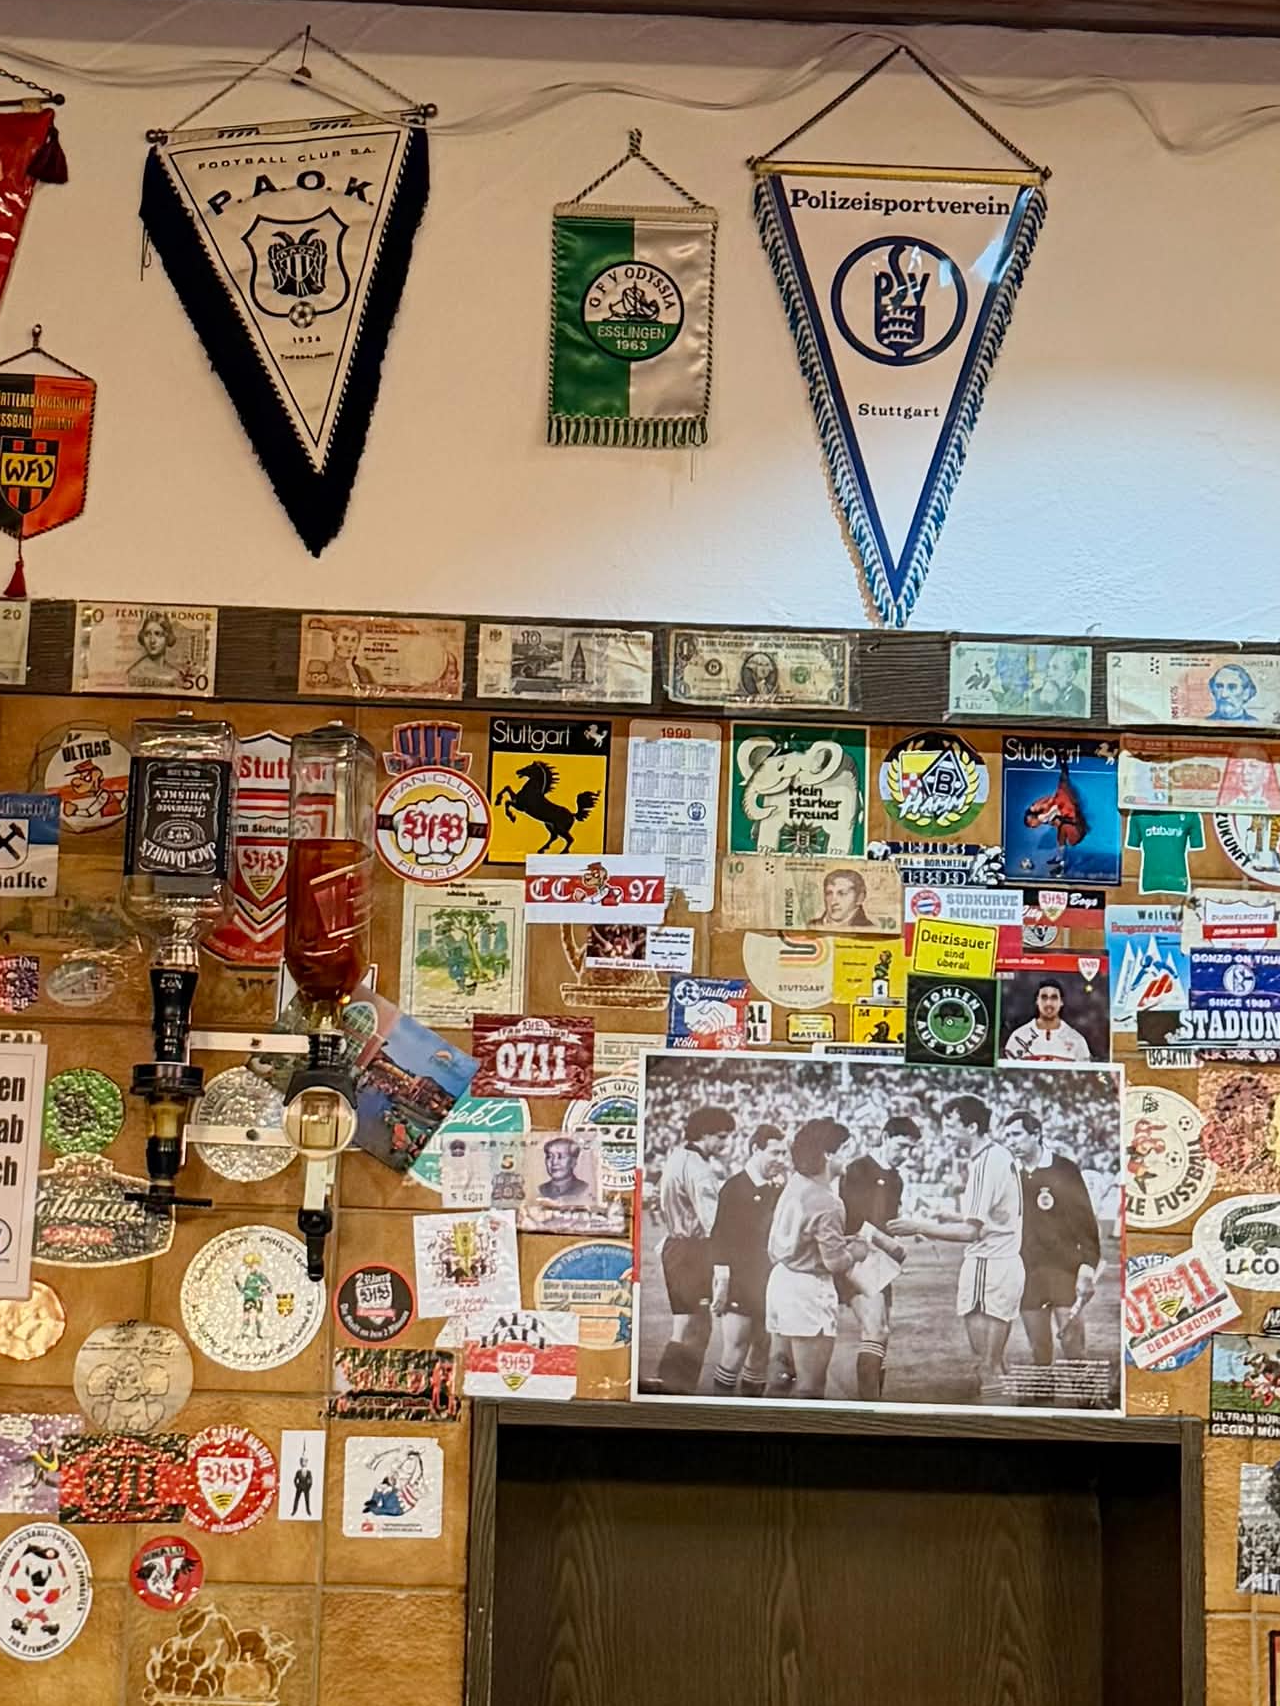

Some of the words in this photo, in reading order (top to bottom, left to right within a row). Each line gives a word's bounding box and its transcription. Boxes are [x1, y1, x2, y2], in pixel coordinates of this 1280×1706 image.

[197, 156, 288, 171] FOOTBALL
[297, 150, 342, 164] CLUB
[789, 188, 1010, 217] Polizeisportverein
[624, 266, 677, 311] ODYSSIA
[596, 324, 667, 342] ESSLINGEN
[614, 340, 649, 353] 1963
[857, 402, 941, 420] Stuttgart
[3, 458, 58, 485] WFV
[1, 608, 23, 622] 20
[520, 629, 542, 646] 10
[181, 673, 210, 691] 50
[491, 718, 572, 751] Stuttgart
[62, 739, 113, 762] ULTRAS
[1004, 739, 1081, 769] Stuttgrt
[386, 769, 483, 811] FAN-CLUB
[788, 783, 823, 798] Mein
[788, 797, 842, 811] starker
[899, 794, 967, 819] HAMM
[788, 808, 840, 822] Freund
[396, 859, 460, 879] FILDER
[628, 877, 660, 903] 97
[946, 892, 1021, 908] SÜDKURVE
[949, 906, 1017, 921] MÜNCHEN
[1210, 913, 1270, 923] DUNKELROTER
[920, 928, 993, 951] Deizisauer
[936, 957, 971, 971] überall
[943, 950, 966, 961] sind
[1191, 952, 1229, 965] GONZO
[1231, 953, 1248, 965] ON
[698, 985, 749, 1002] Stuttgart
[777, 983, 826, 994] STUTTGART
[921, 985, 982, 1013] FOHLEN
[1208, 996, 1243, 1008] SINCE
[672, 1035, 700, 1049] Köln
[916, 1019, 936, 1045] AUS
[944, 1020, 989, 1057] POLEN
[495, 1043, 568, 1081] 0711
[1153, 1139, 1207, 1217] FUSSBALL
[1146, 1306, 1224, 1354] DENKENDORF
[1211, 1411, 1254, 1424] ULTRAS
[1211, 1423, 1256, 1437] GEGEN
